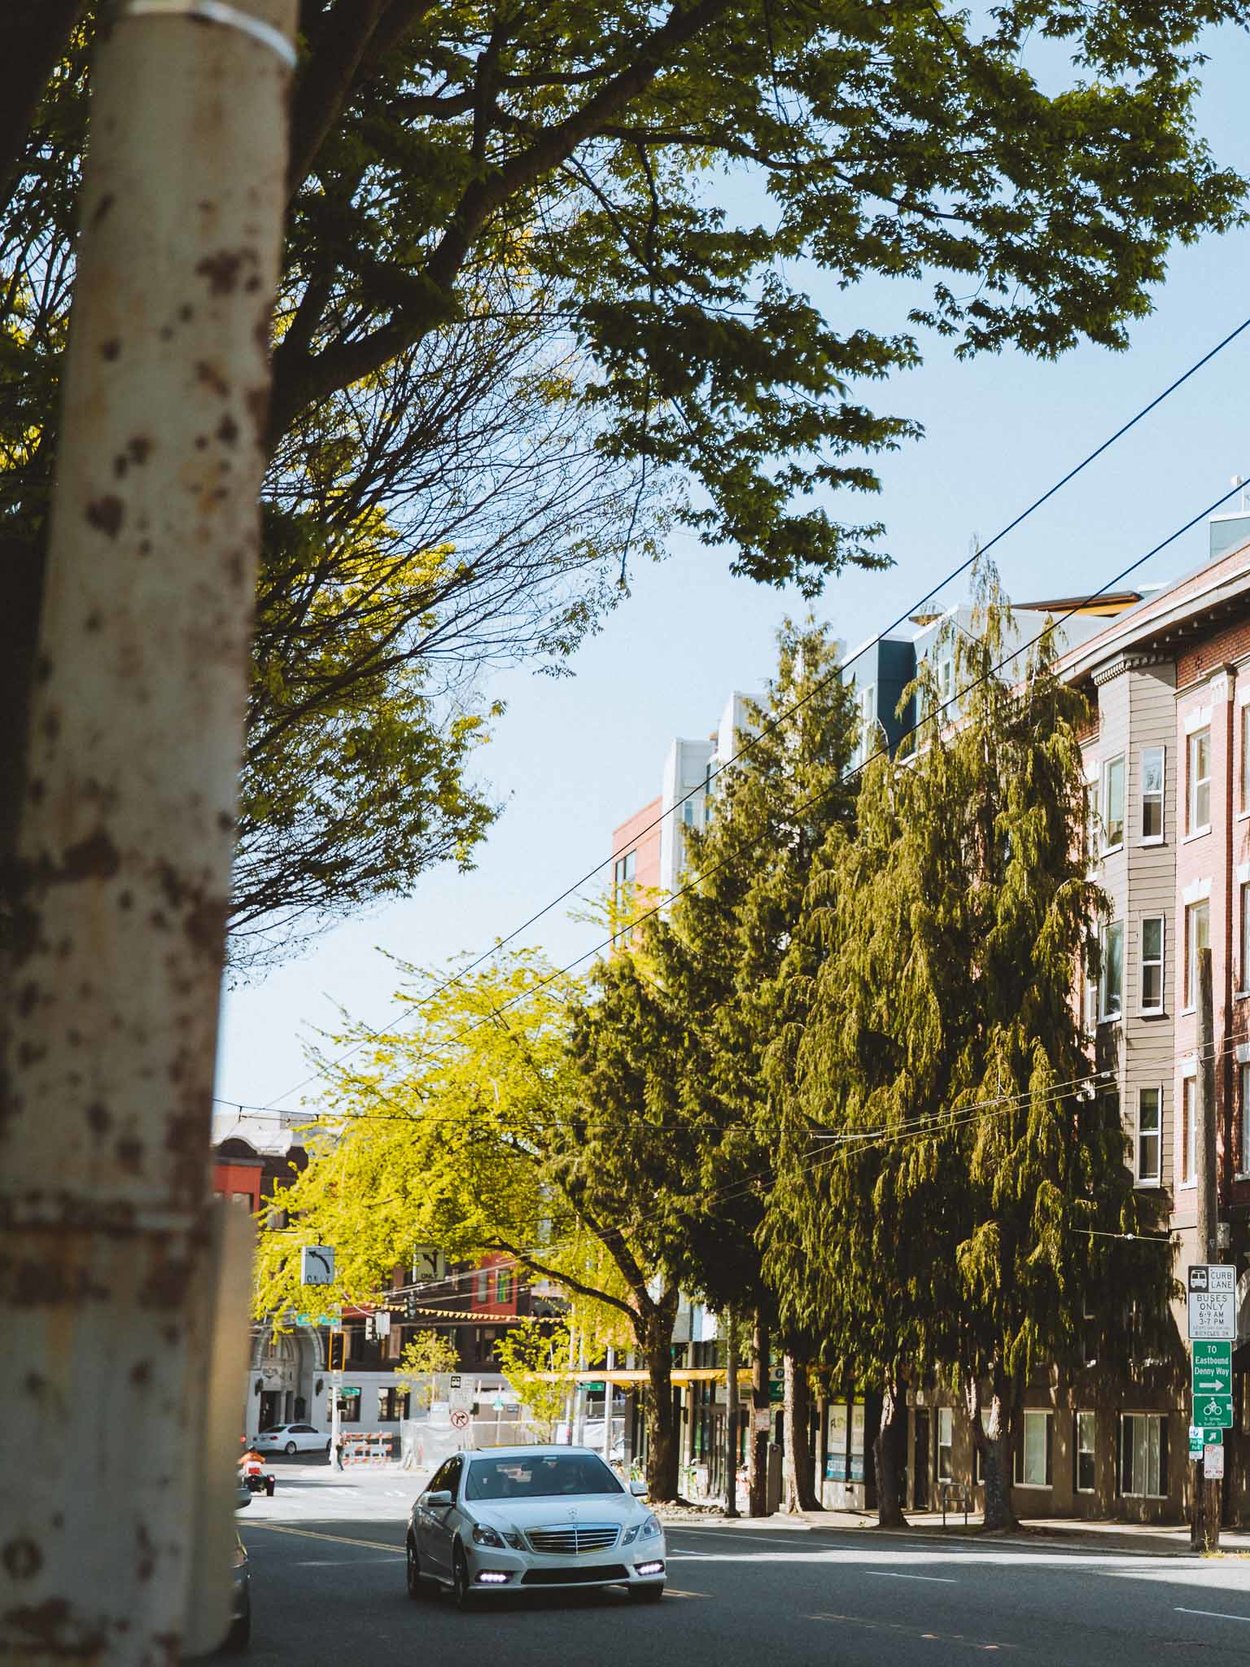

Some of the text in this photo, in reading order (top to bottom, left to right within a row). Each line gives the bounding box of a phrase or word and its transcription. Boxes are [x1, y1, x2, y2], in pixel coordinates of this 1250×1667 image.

[1210, 1272, 1232, 1280] CURB
[1211, 1281, 1232, 1289] LANE
[1196, 1294, 1228, 1302] BUSES
[1200, 1303, 1224, 1311] ONLY
[1207, 1345, 1217, 1354] TO
[1195, 1356, 1229, 1365] Eastbound
[1194, 1367, 1230, 1377] Denny Way
